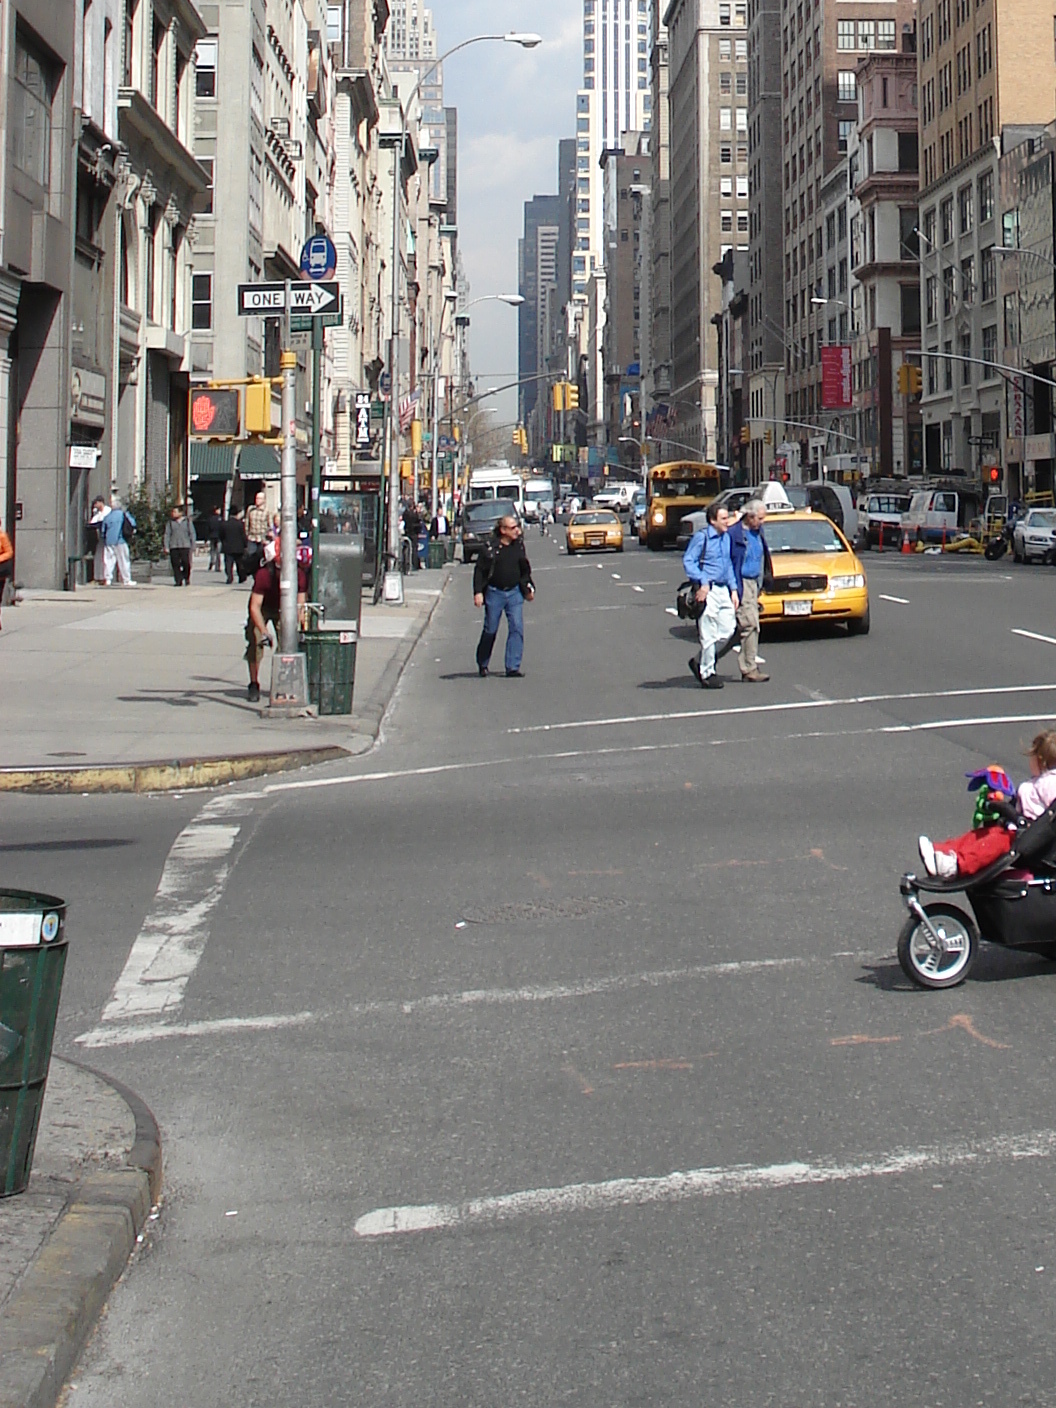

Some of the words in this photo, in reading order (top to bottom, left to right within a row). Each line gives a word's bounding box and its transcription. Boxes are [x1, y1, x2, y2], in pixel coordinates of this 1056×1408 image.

[252, 293, 281, 306] ONE
[294, 292, 324, 305] WAY
[357, 407, 369, 438] ATM
